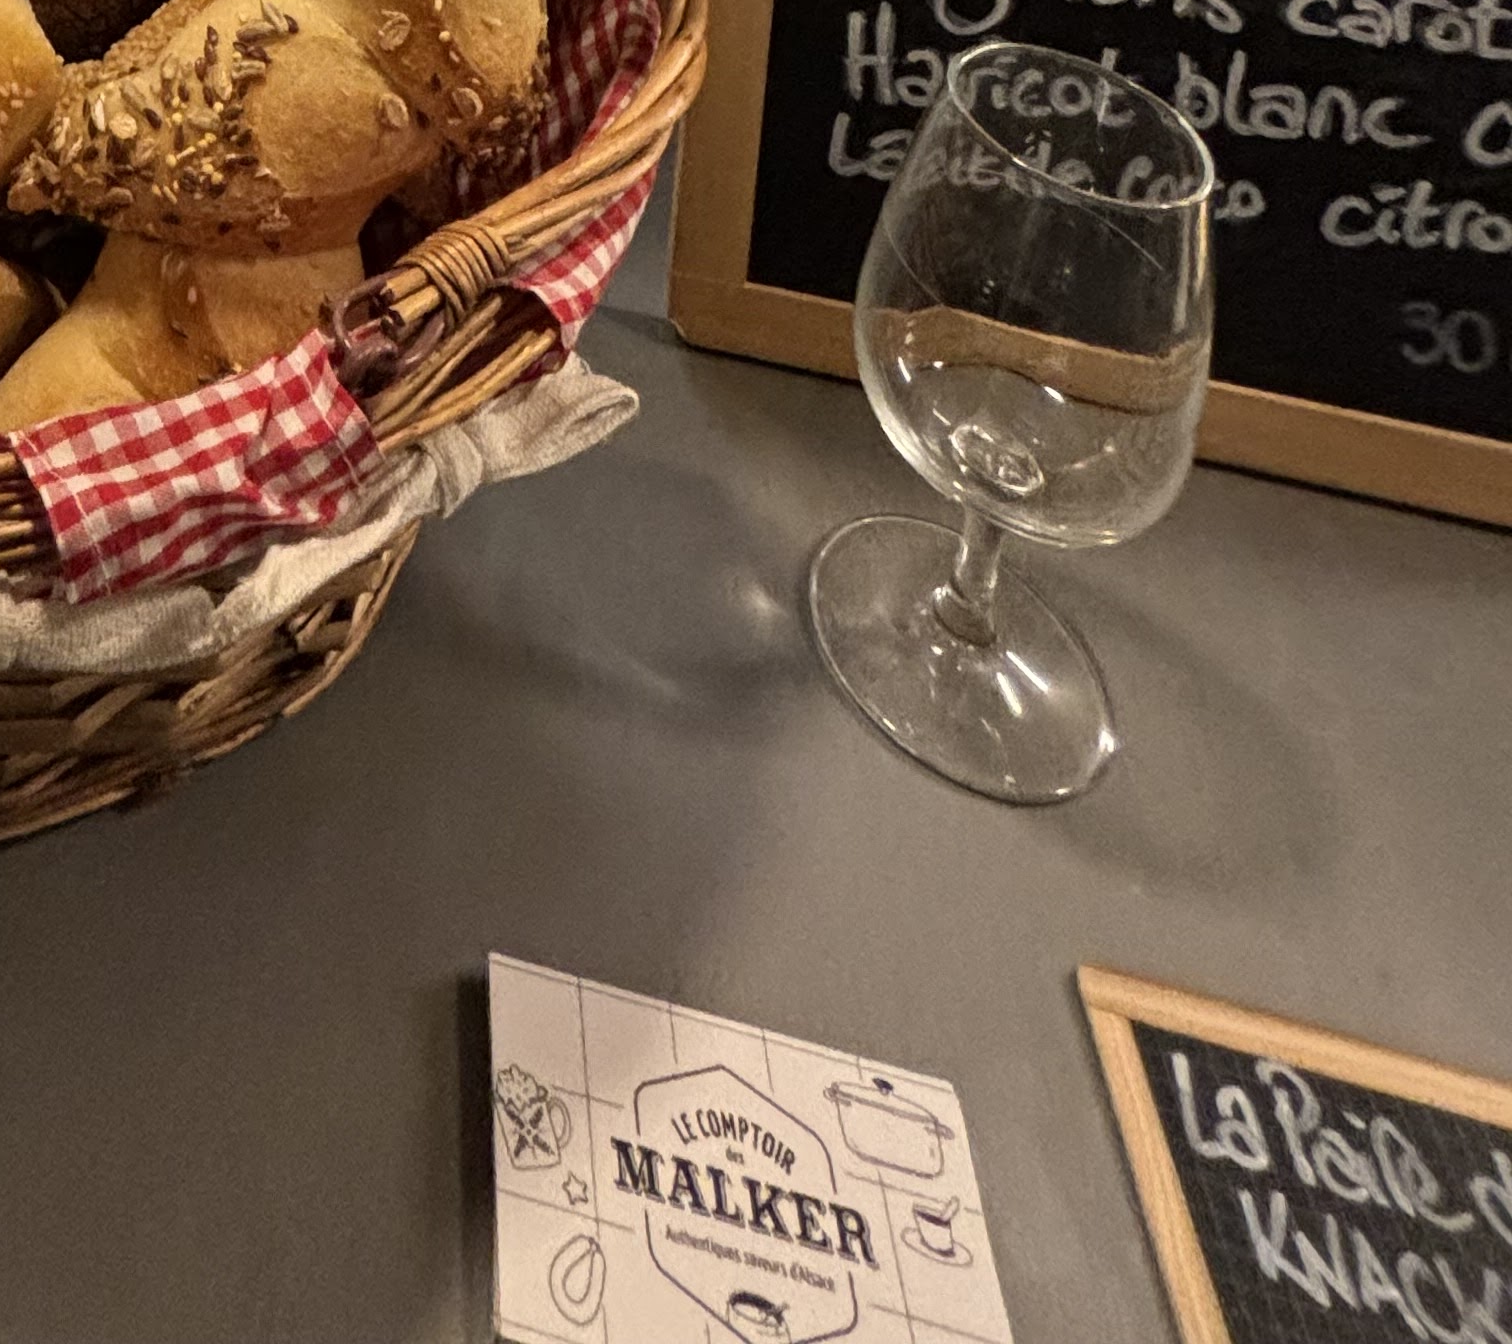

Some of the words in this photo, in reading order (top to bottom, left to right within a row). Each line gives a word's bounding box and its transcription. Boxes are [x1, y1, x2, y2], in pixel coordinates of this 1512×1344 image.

[1175, 49, 1432, 148] blanc
[671, 1112, 698, 1144] LE
[696, 1109, 796, 1175] COMPTOIR
[1172, 1053, 1269, 1171] La
[610, 1136, 880, 1270] MALKER
